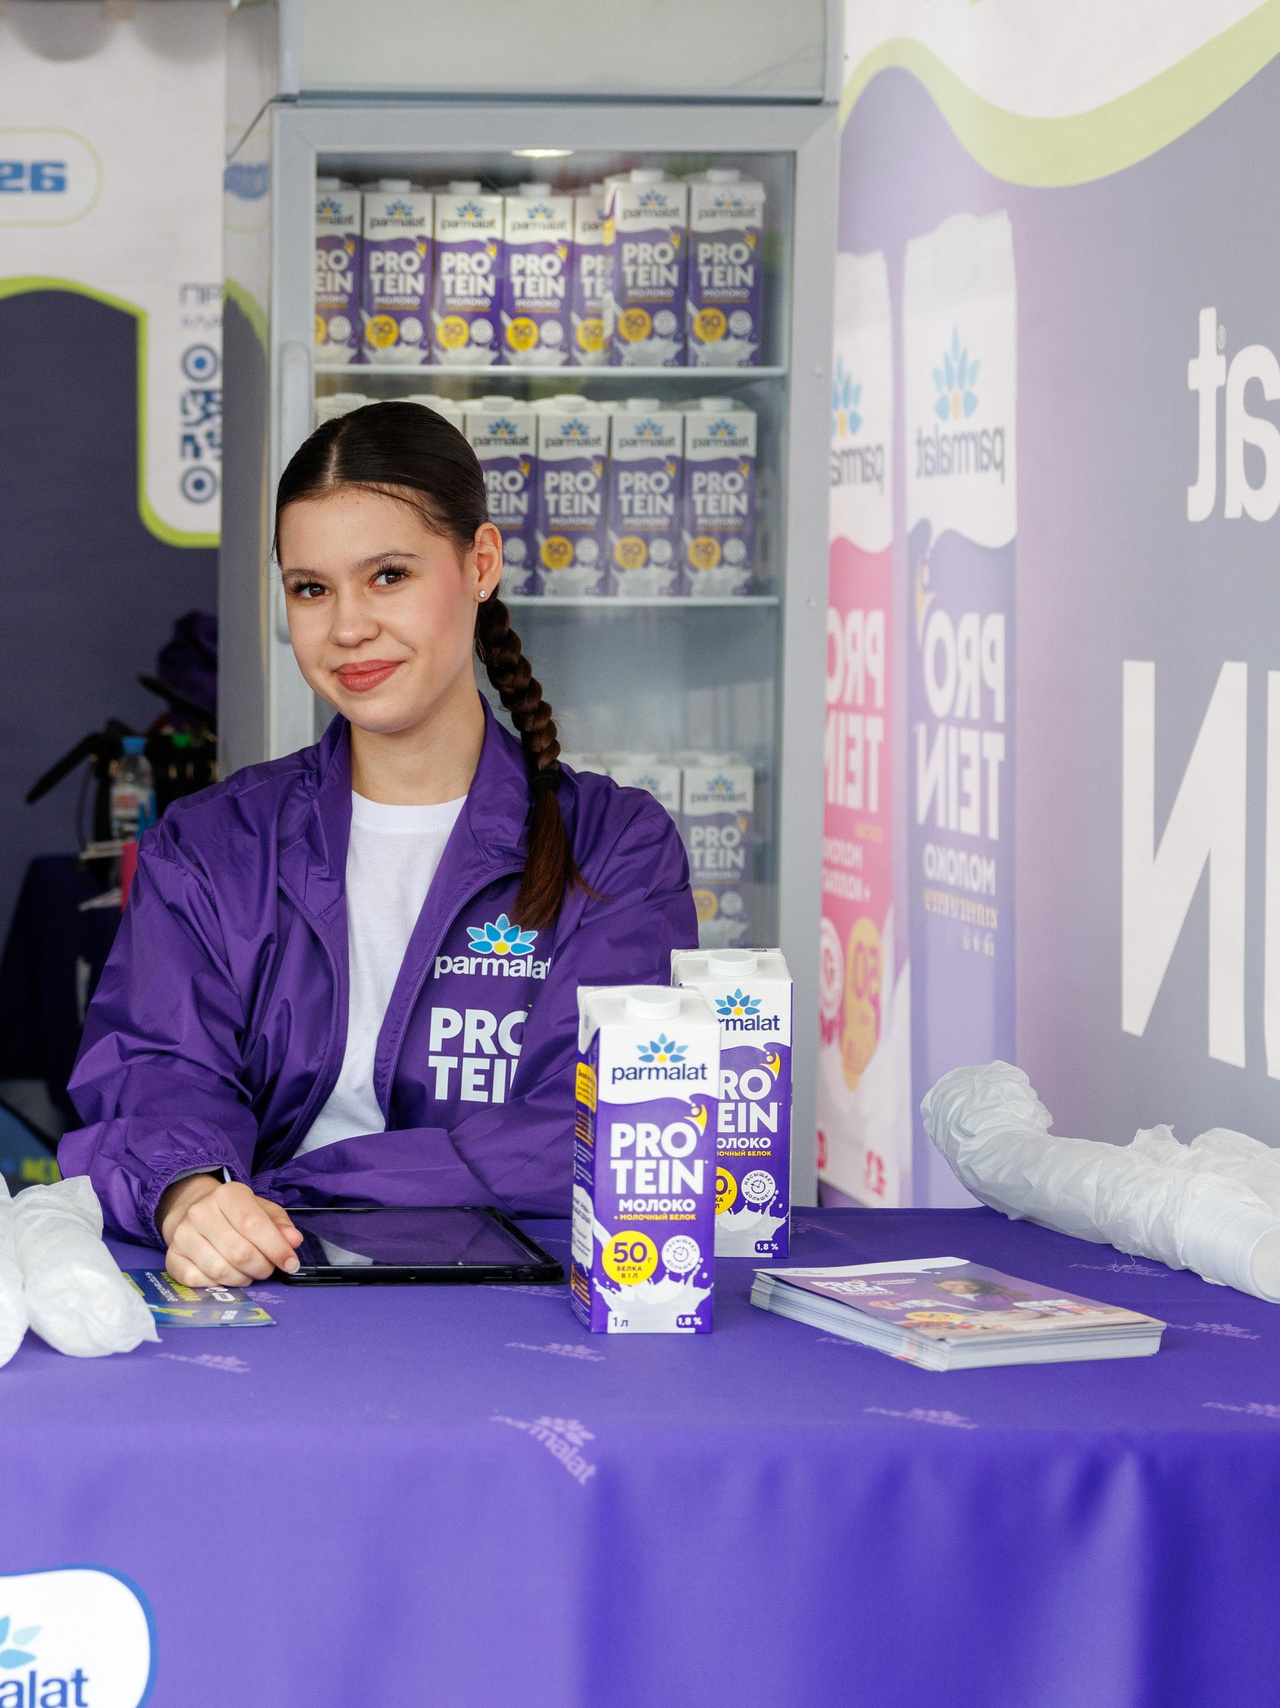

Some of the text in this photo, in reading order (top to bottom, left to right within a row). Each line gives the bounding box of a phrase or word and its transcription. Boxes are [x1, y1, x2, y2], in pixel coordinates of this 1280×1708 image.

[370, 250, 422, 274] PRO
[441, 251, 493, 275] PRO
[510, 253, 562, 277] PRO
[622, 242, 675, 266] PRO
[697, 242, 750, 266] PRO
[370, 272, 425, 296] TEIN
[441, 274, 496, 297] TEIN
[511, 276, 566, 298] TEIN
[623, 264, 679, 288] TEIN
[698, 264, 755, 288] TEIN
[545, 471, 597, 494] PRO
[619, 471, 671, 495] PRO
[692, 471, 744, 495] PRO
[488, 493, 528, 515] EIN
[545, 493, 601, 515] TEIN
[619, 494, 675, 516] TEIN
[692, 494, 748, 516] TEIN
[690, 826, 742, 849] PRO
[691, 848, 745, 870] TEIN
[611, 1063, 708, 1085] parmalat
[720, 1068, 772, 1101] RO
[717, 1101, 778, 1133] EIN
[610, 1121, 698, 1159] PRO
[717, 1137, 772, 1150] ОЛОКО
[717, 1149, 746, 1157] ОЧНЫЙ
[610, 1158, 705, 1195] TEIN
[716, 1175, 728, 1196] 0
[744, 1171, 773, 1186] НАСЫЩАЕТ
[618, 1198, 697, 1213] МОЛОКО
[620, 1213, 669, 1221] МОЛОЧНЫЙ
[613, 1241, 648, 1263] 50
[756, 1243, 779, 1252] 1,8 %
[612, 1316, 629, 1328] 1 л
[677, 1316, 703, 1326] 1,8 %
